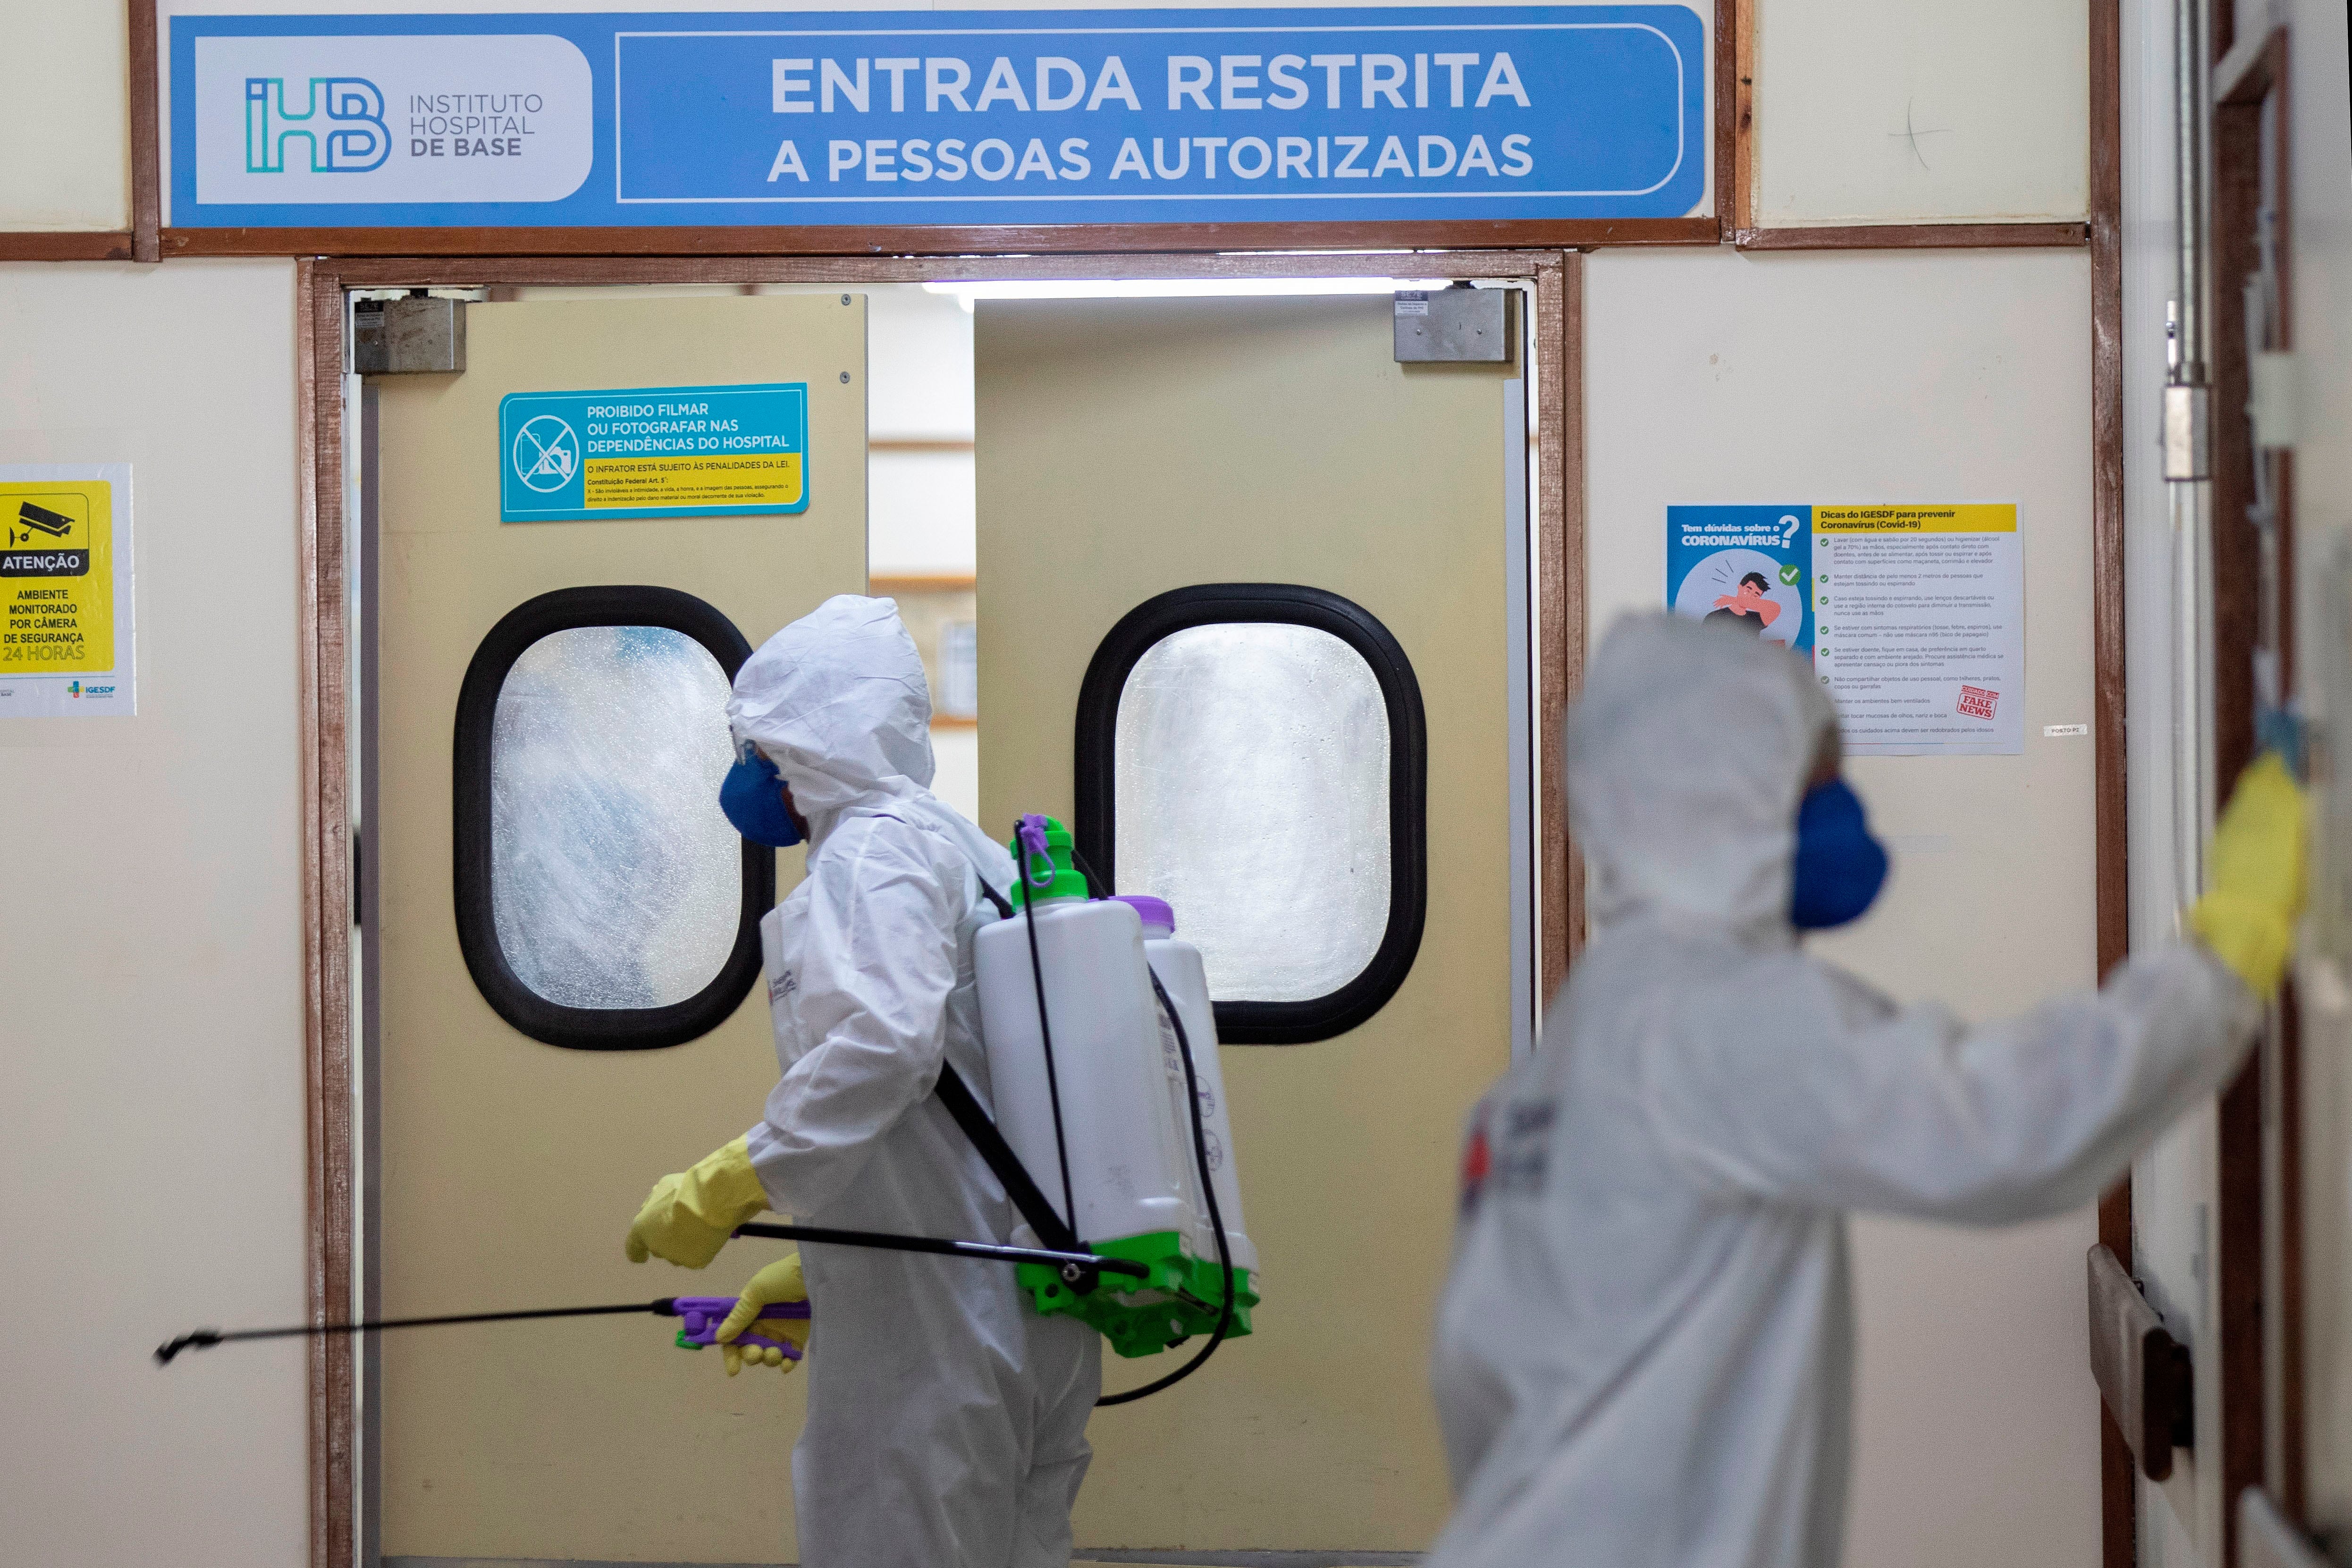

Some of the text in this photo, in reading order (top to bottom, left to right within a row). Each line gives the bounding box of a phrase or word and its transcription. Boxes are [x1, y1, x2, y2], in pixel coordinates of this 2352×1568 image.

[772, 52, 1531, 113] ENTRADA RESTRITA
[410, 94, 543, 113] INSTITUTO
[411, 116, 535, 135] HOSPITAL
[411, 138, 522, 157] DE BASE
[767, 134, 1533, 182] A PESSOAS AUTORIZADAS
[587, 403, 708, 418] PROIBIDO FILMAR
[587, 419, 739, 436] OU FOTOGRAFAR NAS
[588, 435, 789, 453] DEPENDÊNCIAS DO HOSPITAL
[596, 464, 636, 473] INFRATOR
[637, 463, 657, 472] ESTÁ
[659, 463, 691, 472] SUJEITO
[693, 461, 704, 470] ÀS
[706, 461, 761, 470] PENALIDADES
[776, 460, 790, 468] LEI.
[1821, 511, 1846, 519] Dicas
[1860, 510, 1895, 518] IGESDF
[1896, 512, 1916, 520] para
[1918, 510, 1956, 520] prevenir
[1681, 524, 1703, 532] Tem
[1704, 523, 1742, 532] dúvidas
[1744, 523, 1771, 532] sobre
[1821, 520, 1921, 530] Coronavírus (Covid-19)
[2, 553, 80, 572] ATENÇÃO
[17, 589, 68, 600] AMBIENTE
[9, 604, 77, 615] MONITORADO
[10, 616, 77, 629] POR CÂMERA
[4, 632, 84, 645] DE SEGURANÇA
[2, 644, 85, 662] 24 HORAS
[1963, 695, 1993, 709] FAKE
[1959, 703, 1992, 718] NEWS
